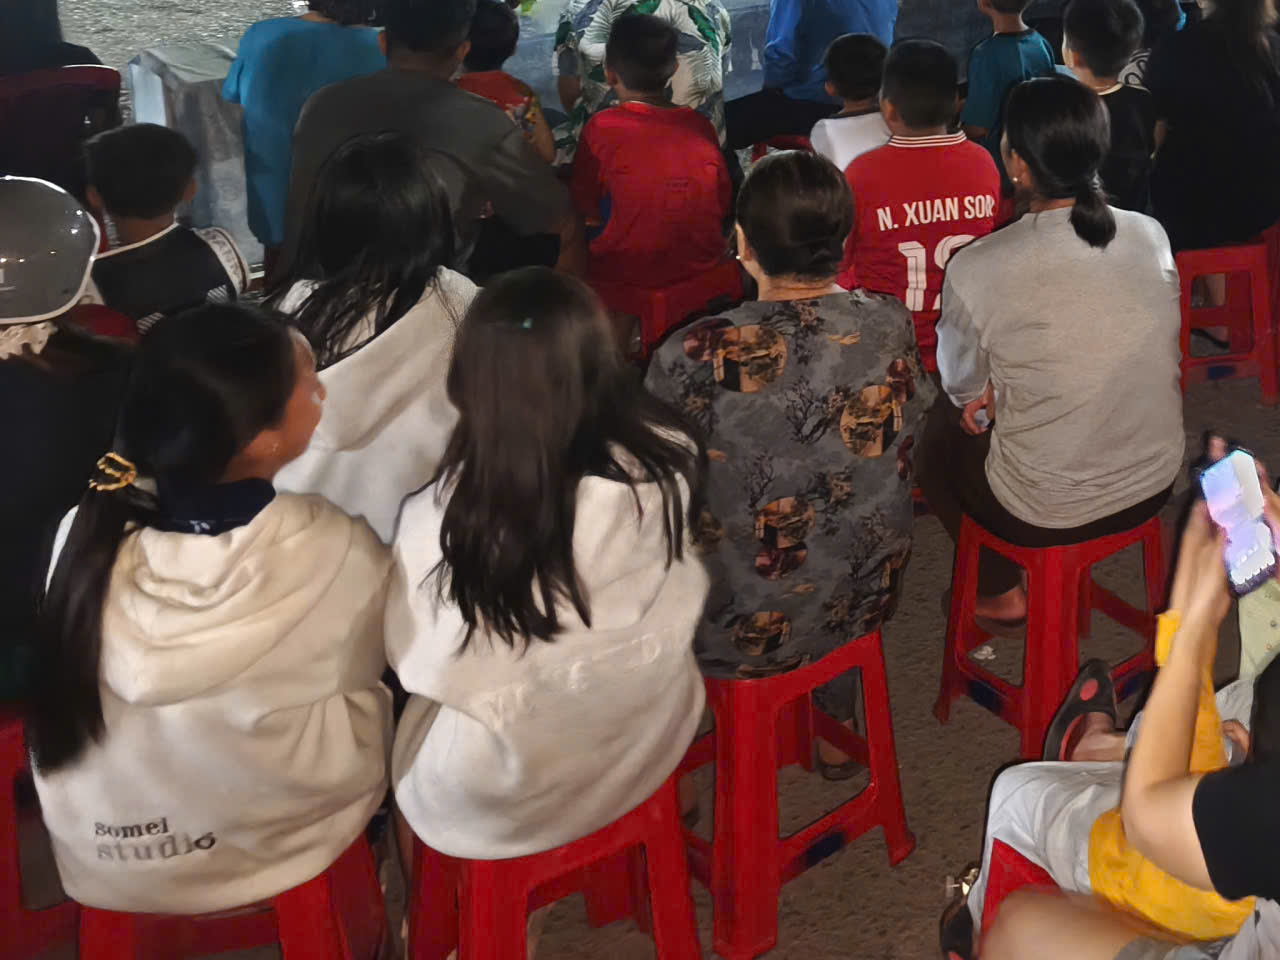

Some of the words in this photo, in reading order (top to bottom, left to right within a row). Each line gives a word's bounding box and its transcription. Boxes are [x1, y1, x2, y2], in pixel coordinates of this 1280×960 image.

[876, 206, 899, 231] N.
[903, 197, 959, 227] XUAN
[97, 831, 217, 861] studio
